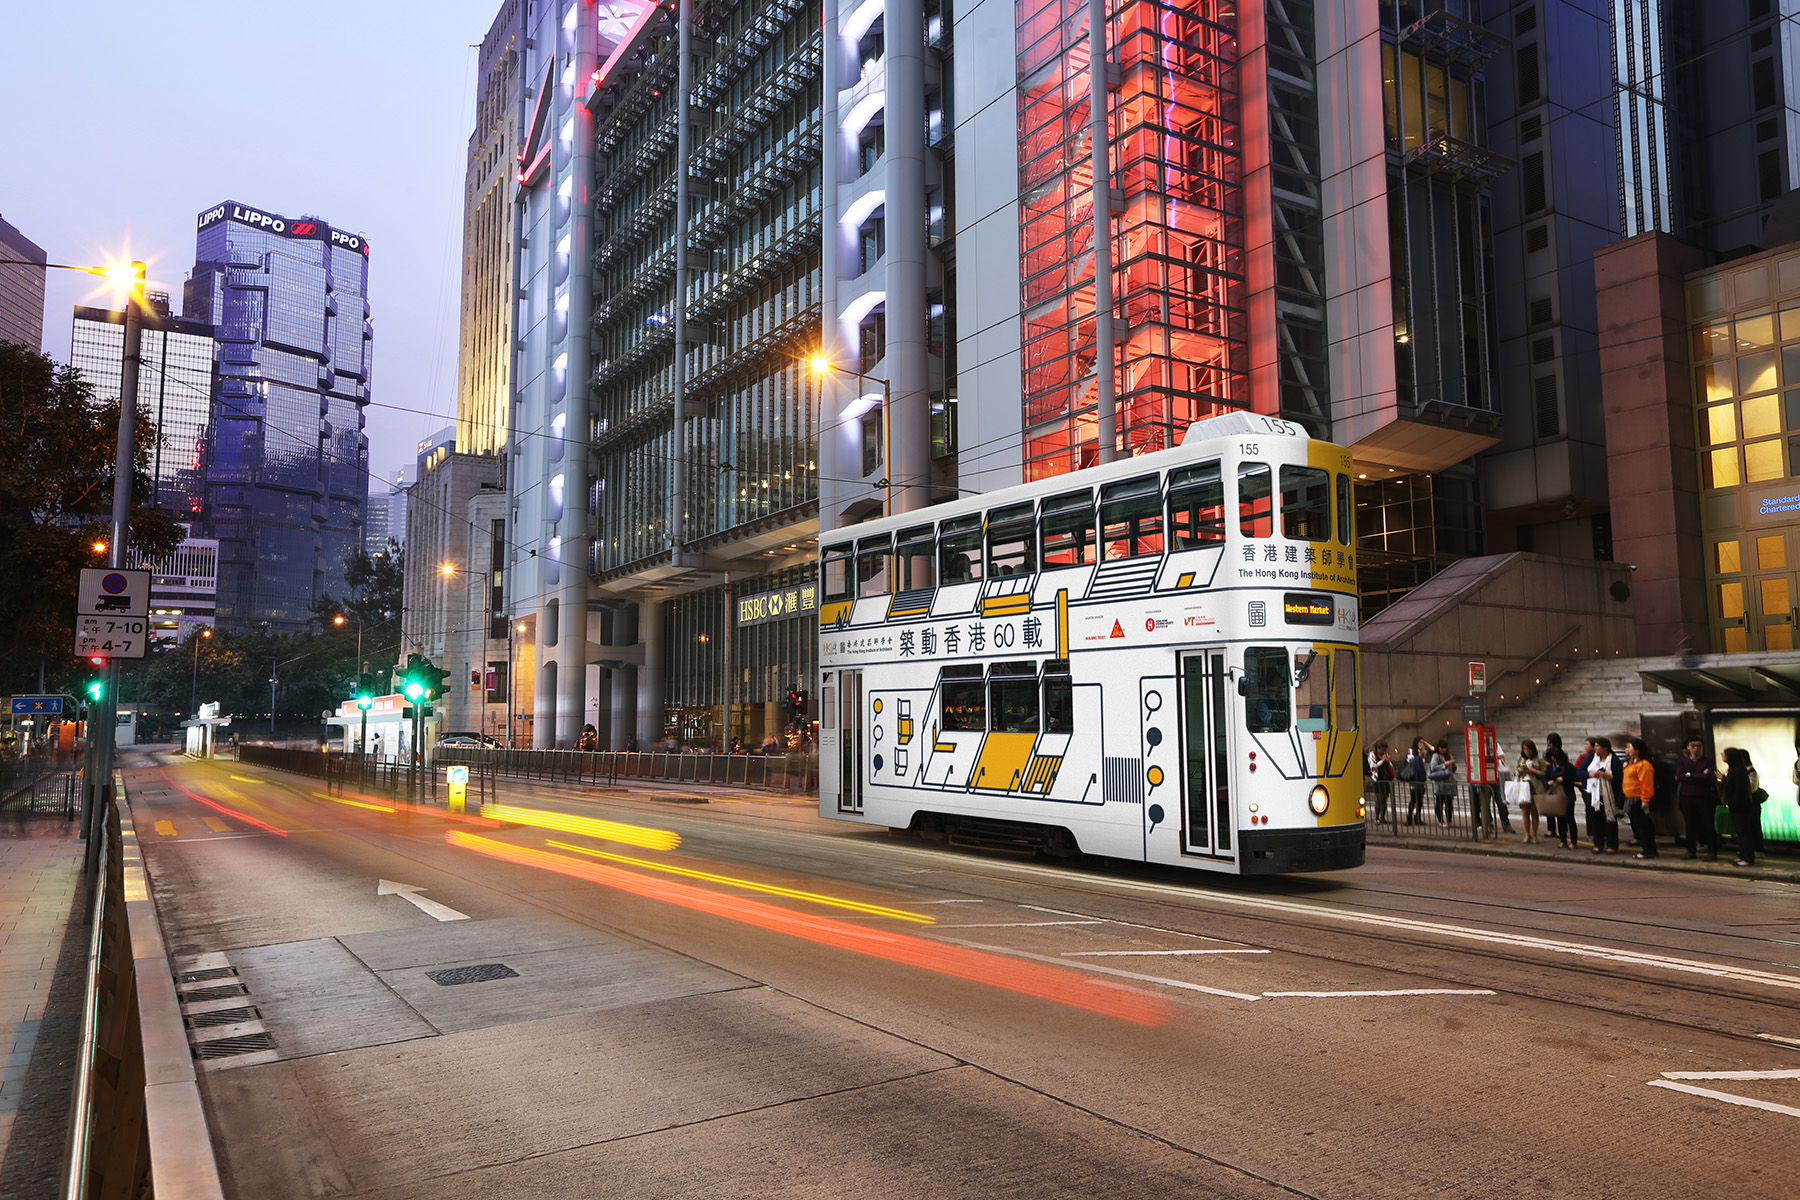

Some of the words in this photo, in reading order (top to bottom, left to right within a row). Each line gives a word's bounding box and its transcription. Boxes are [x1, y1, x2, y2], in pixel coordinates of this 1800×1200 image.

[198, 206, 225, 228] LIPPO
[233, 206, 285, 232] LIPPO
[331, 231, 359, 248] PPO
[1261, 417, 1296, 436] 155
[1239, 443, 1260, 455] 155
[1340, 455, 1351, 469] 155
[1762, 494, 1800, 506] Standard
[1759, 502, 1800, 515] Chartered
[1242, 543, 1354, 571] 香港建築師學會
[1238, 569, 1253, 578] The
[1255, 569, 1276, 580] Hong
[1278, 569, 1299, 580] Kong
[1300, 570, 1329, 582] Institute
[1329, 573, 1336, 582] of
[740, 596, 768, 622] HSBC
[1284, 604, 1308, 614] Western
[1309, 605, 1330, 615] Market
[105, 621, 143, 634] 7-10
[101, 640, 132, 652] 4-7
